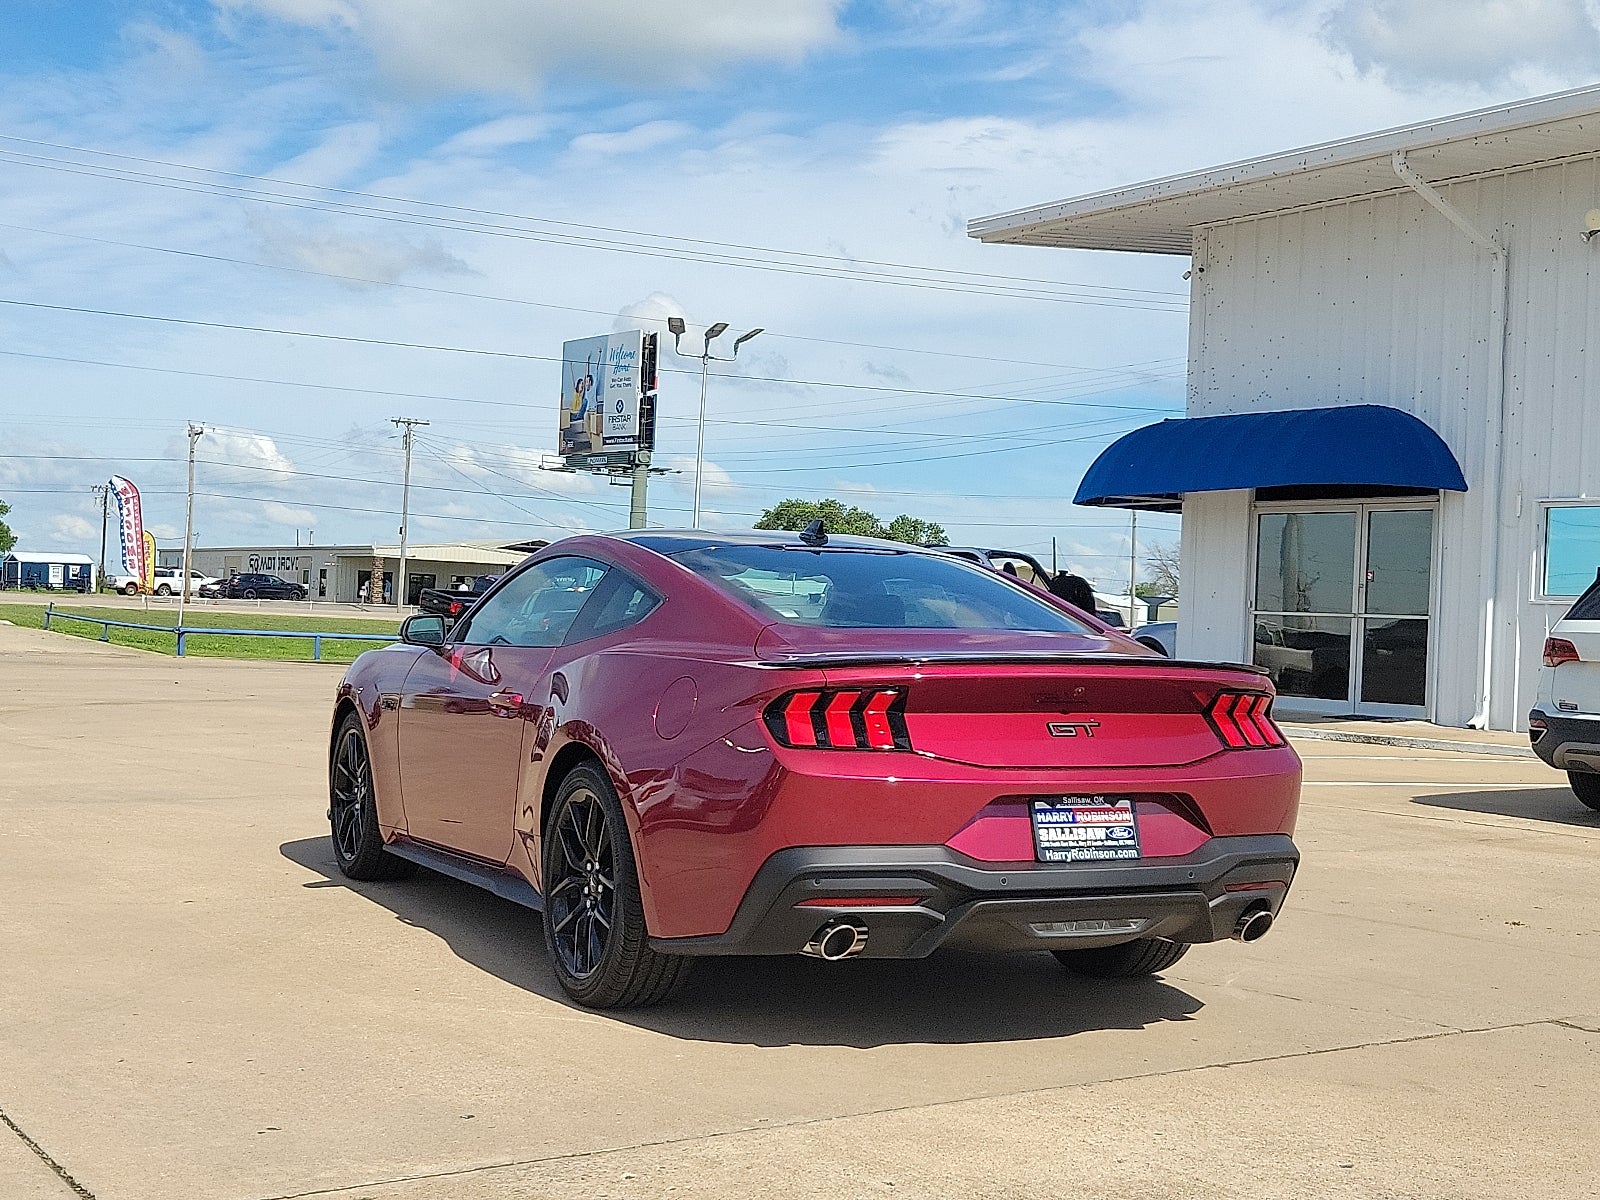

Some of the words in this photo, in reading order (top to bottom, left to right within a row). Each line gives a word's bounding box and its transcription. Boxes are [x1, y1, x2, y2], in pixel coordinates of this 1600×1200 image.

[1046, 722, 1101, 737] GT
[1037, 812, 1073, 822] HARRY
[1076, 811, 1131, 822] ROBINSON
[1039, 828, 1106, 840] SALLISAW
[1109, 828, 1130, 837] Ford
[1045, 848, 1138, 862] HarryRobinson.com
